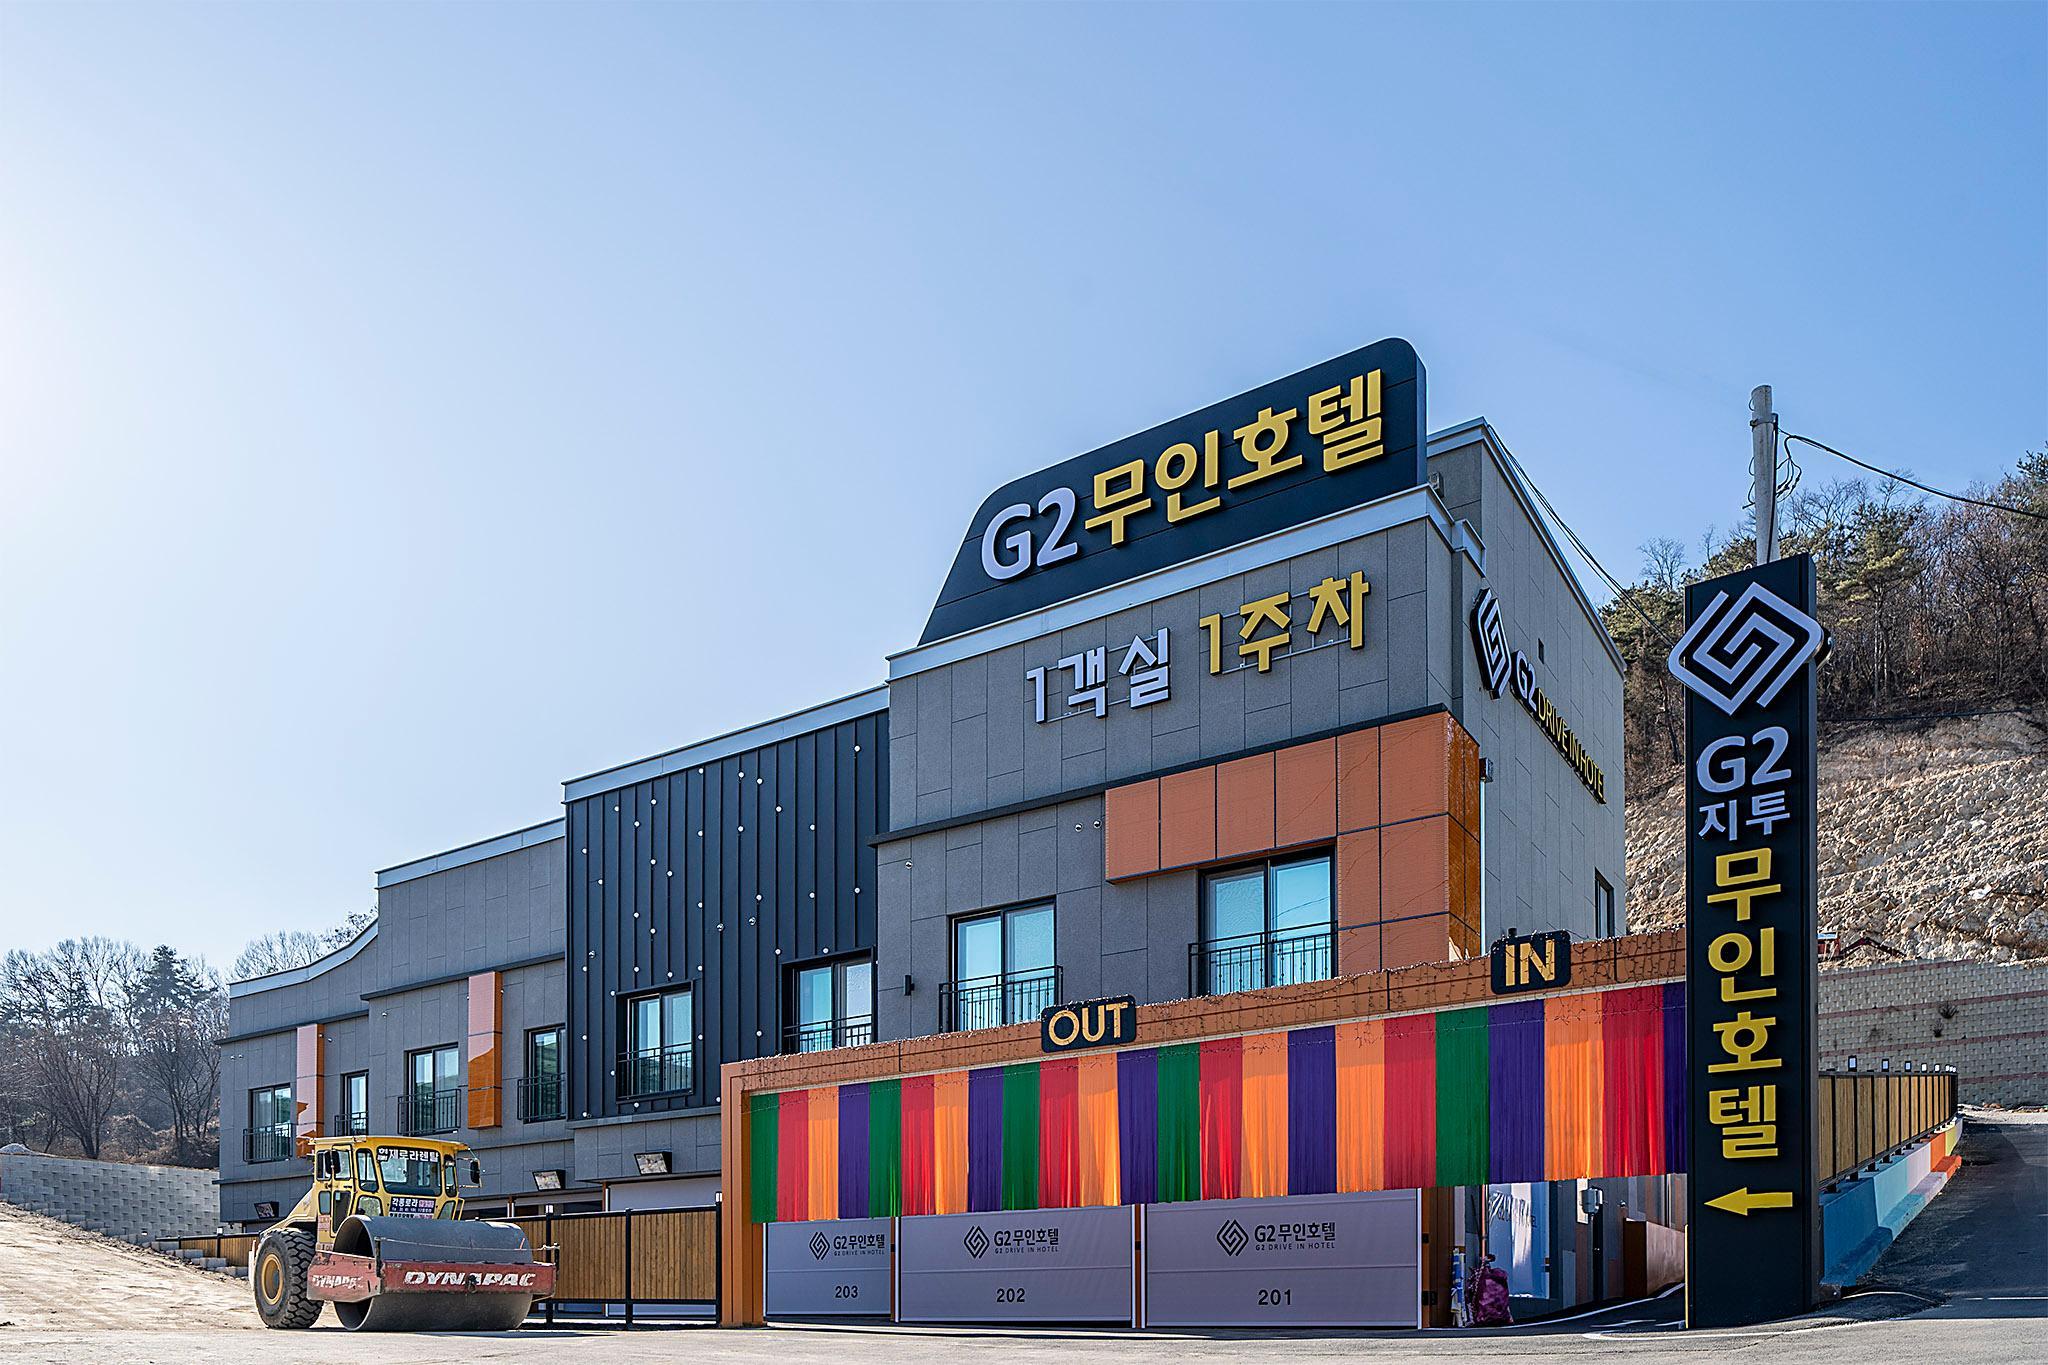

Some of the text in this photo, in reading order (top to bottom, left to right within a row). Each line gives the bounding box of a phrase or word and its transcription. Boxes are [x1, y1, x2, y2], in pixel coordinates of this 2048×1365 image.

[1027, 570, 1370, 724] 1객실 1주차
[1516, 650, 1537, 712] G2
[1538, 687, 1568, 752] DRIVE
[1569, 729, 1580, 767] IN
[1696, 726, 1792, 793] G2
[1698, 790, 1790, 841] 지투
[1506, 939, 1555, 986] IN
[1048, 1002, 1127, 1046] OUT
[1706, 847, 1783, 1161] 무인호텔
[1037, 1245, 1058, 1253] HOTEL
[1308, 1241, 1335, 1249] HOTEL
[403, 1271, 536, 1287] DYNAPAC
[835, 1285, 858, 1298] 203
[996, 1287, 1025, 1303] 202
[1258, 1289, 1291, 1305] 201
